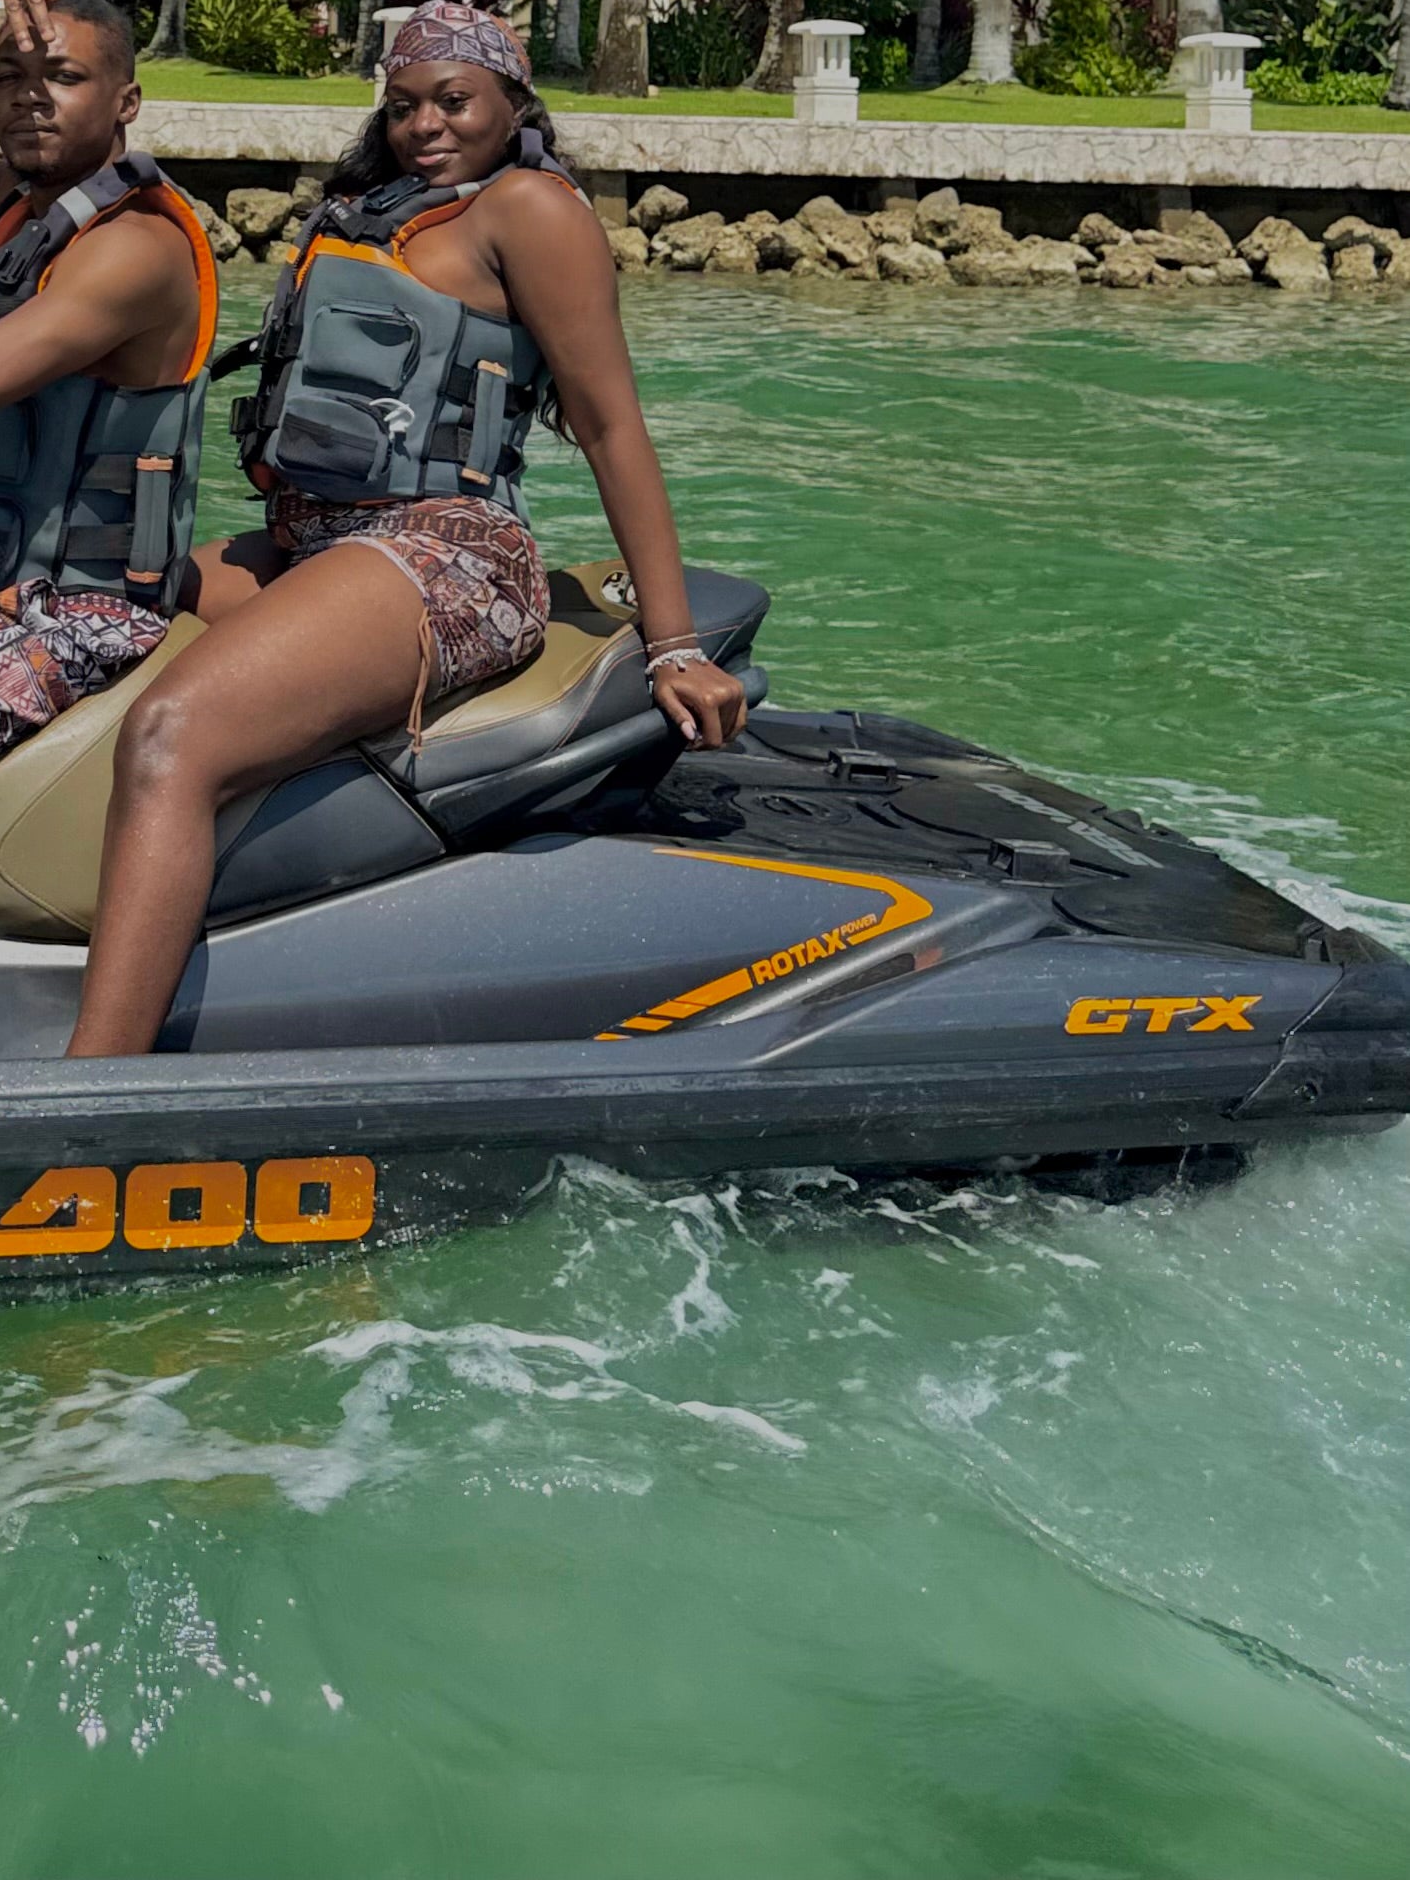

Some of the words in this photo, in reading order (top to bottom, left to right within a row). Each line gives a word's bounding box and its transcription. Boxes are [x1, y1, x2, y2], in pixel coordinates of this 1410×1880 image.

[751, 927, 847, 986] ROTAX
[840, 913, 878, 937] POWER
[1064, 995, 1263, 1035] GTX
